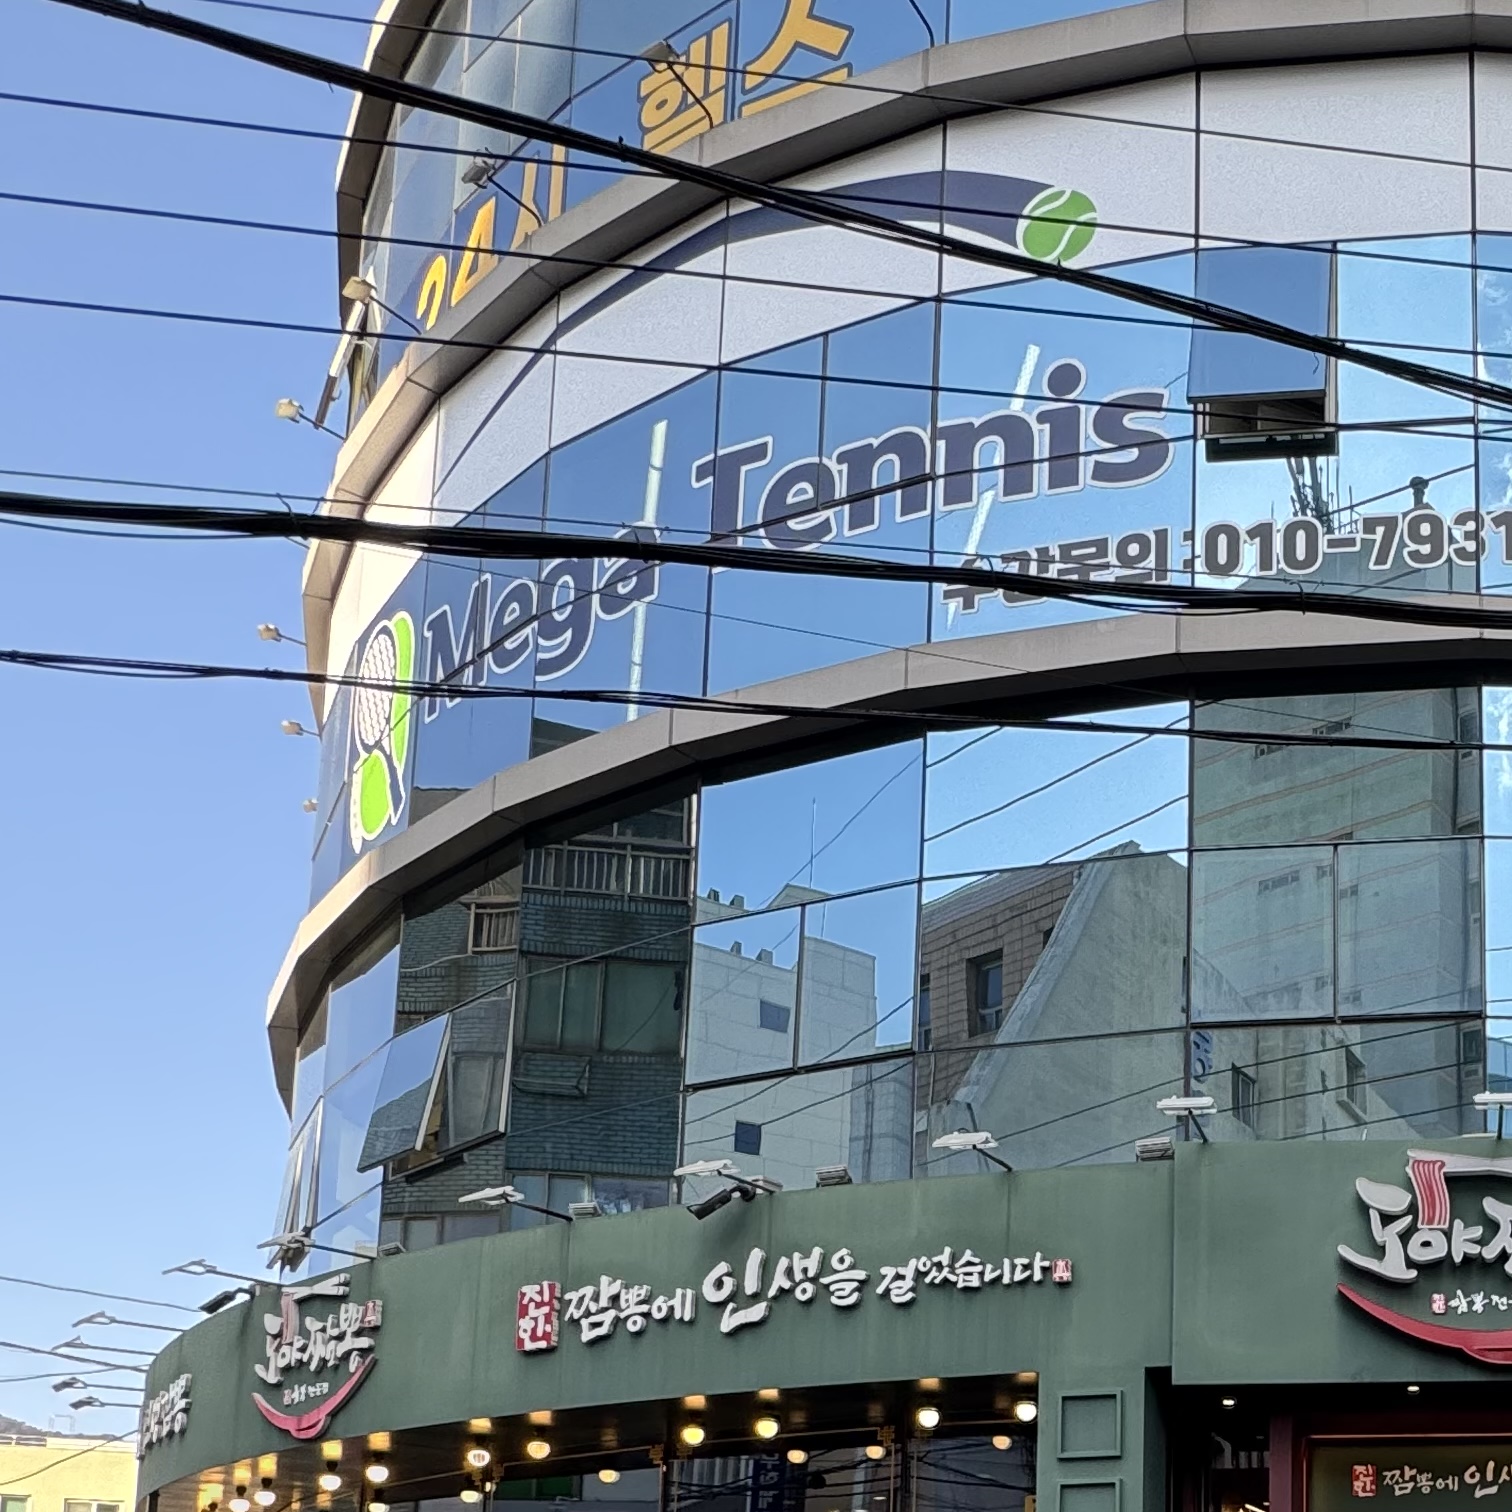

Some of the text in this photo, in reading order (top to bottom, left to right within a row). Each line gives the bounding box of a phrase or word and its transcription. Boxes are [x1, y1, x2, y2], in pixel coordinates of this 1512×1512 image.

[424, 359, 1176, 725] Mega Tennis
[517, 1244, 1050, 1351] 진한 짬뽕에 인생을 걸었습니다
[1382, 1464, 1459, 1497] 짬뽕에
